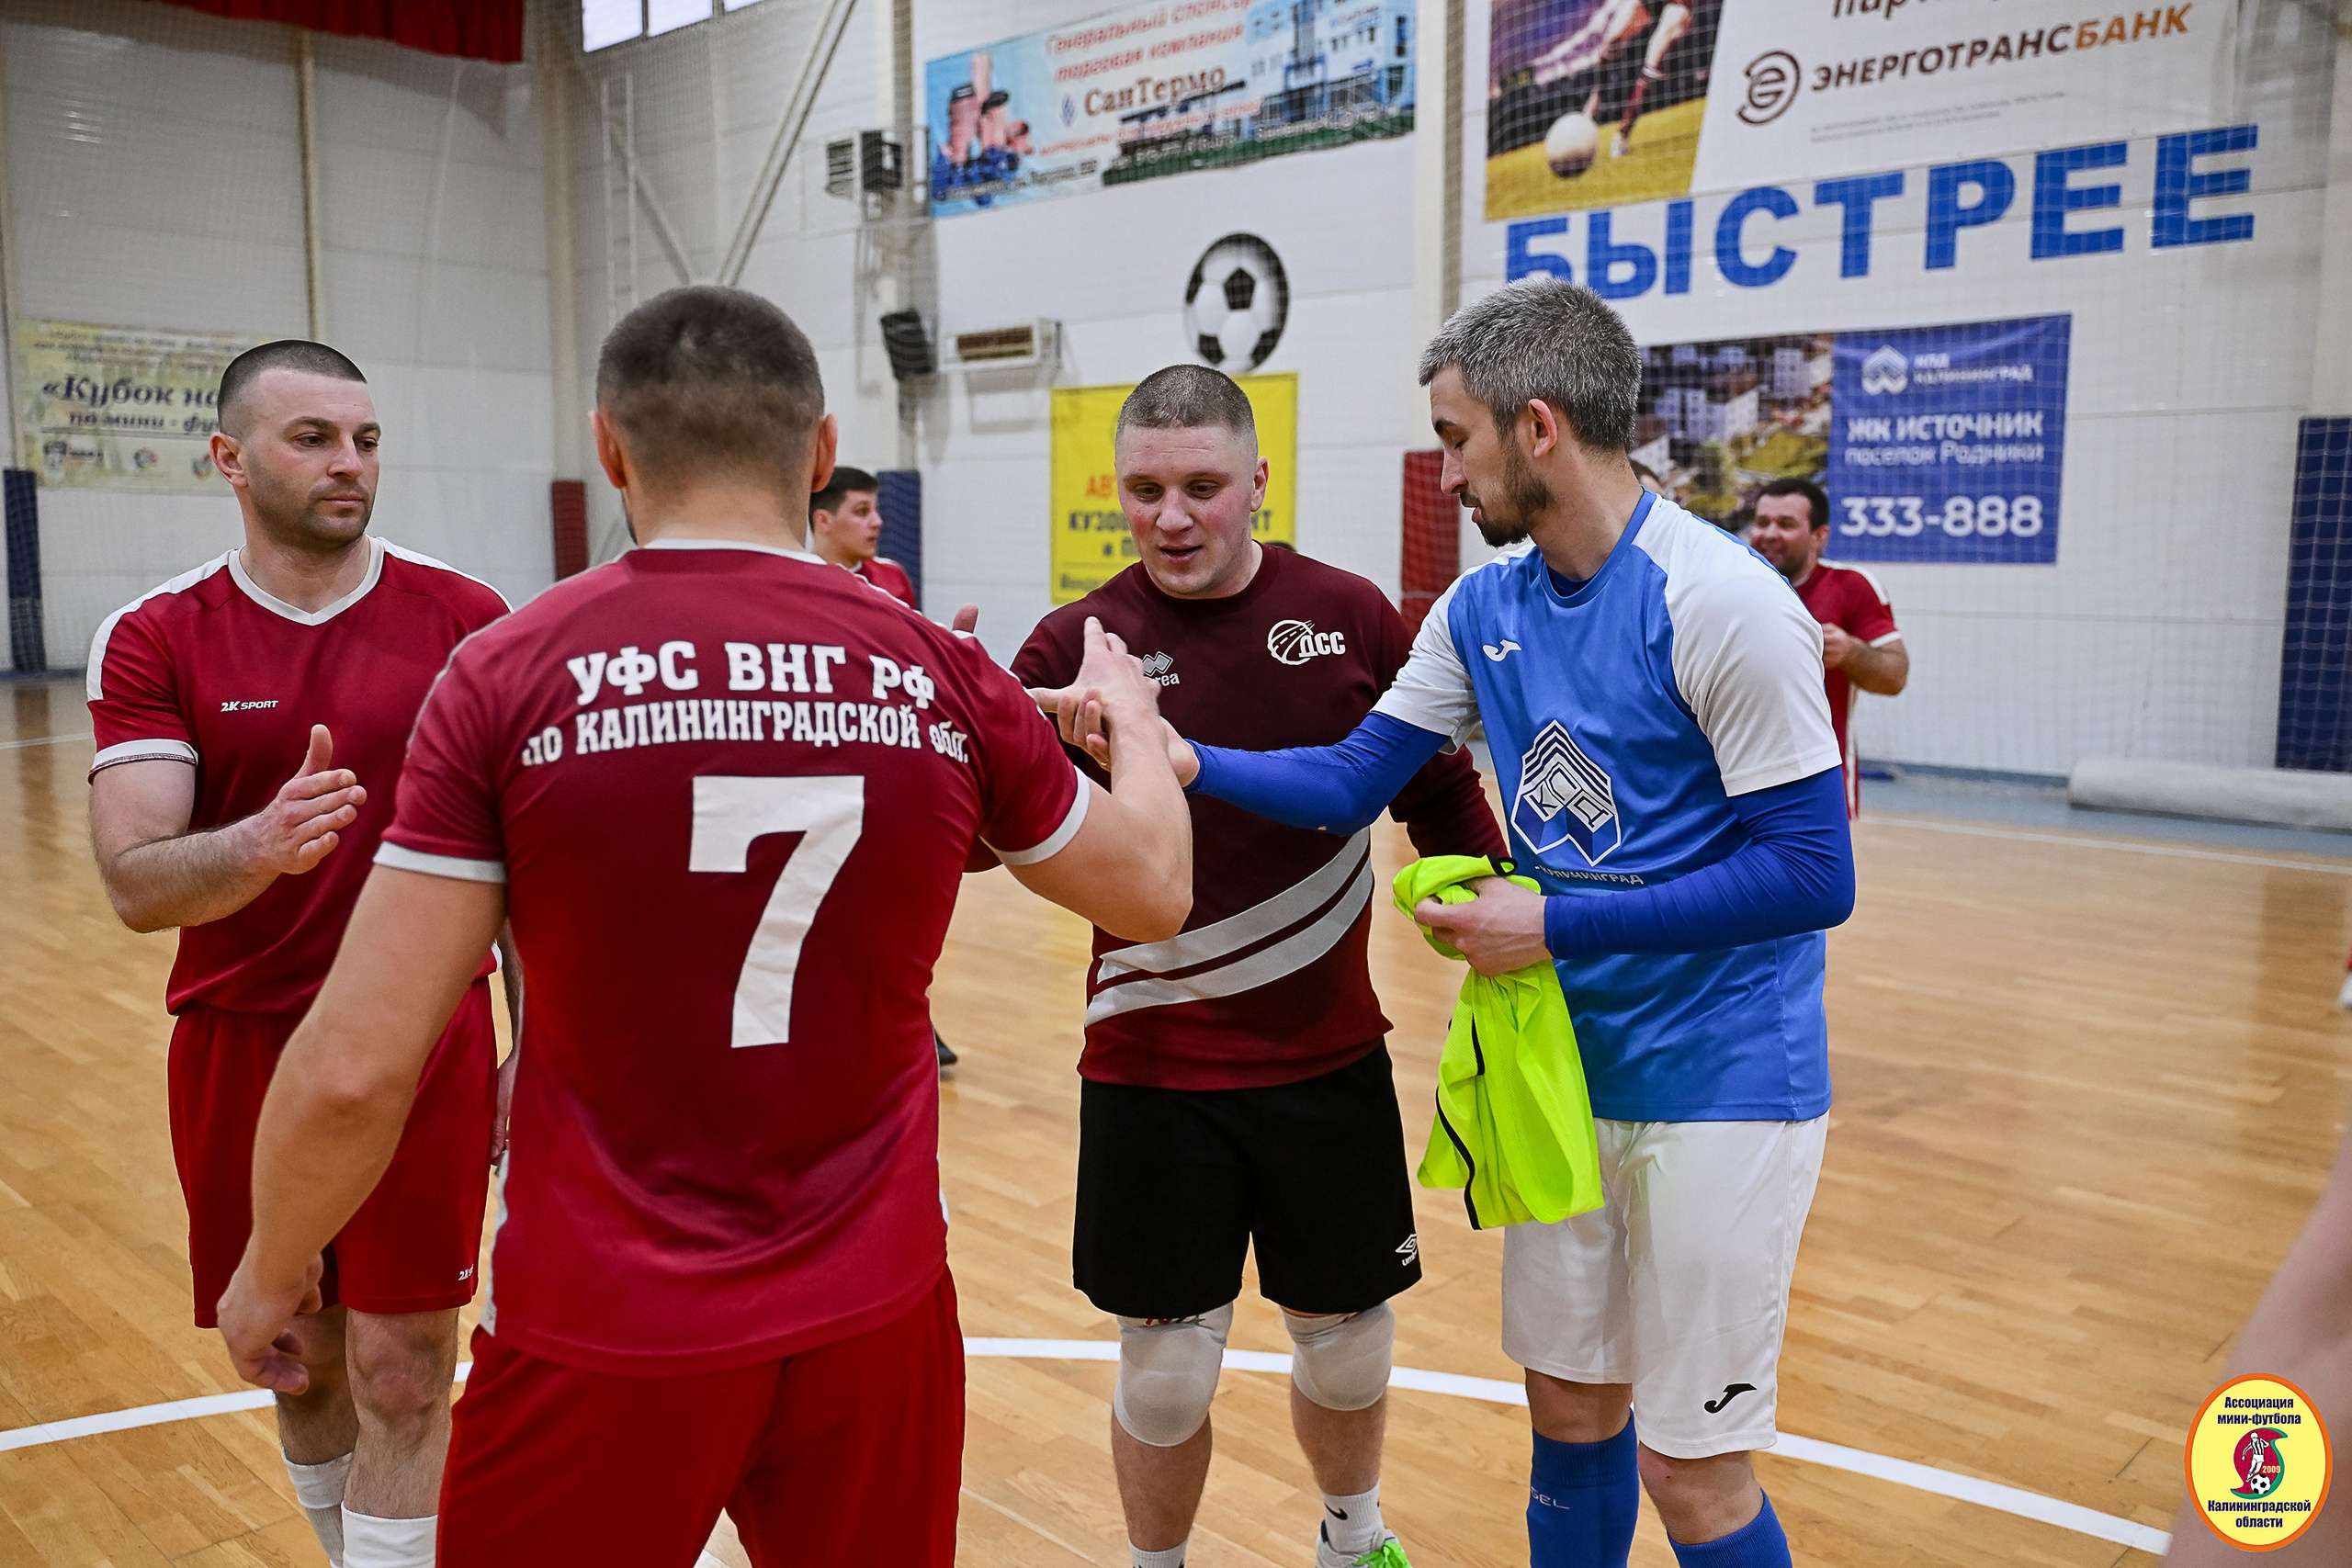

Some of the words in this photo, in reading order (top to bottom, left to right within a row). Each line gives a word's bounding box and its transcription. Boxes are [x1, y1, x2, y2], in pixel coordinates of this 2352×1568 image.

[1811, 4, 2193, 93] ЭНЕРГОТРАНСБАНК
[1084, 66, 1226, 117] СанТермо
[1505, 125, 2258, 300] БЫСТРЕЕ
[1847, 417, 1892, 443] ЖК
[1896, 410, 2043, 442] ИСТОЧНИК
[1839, 495, 2043, 537] 333-888
[1298, 631, 1346, 659] ДСС
[567, 640, 700, 705] УФС
[724, 641, 846, 694] ВНГ
[868, 654, 935, 710] РФ
[240, 700, 278, 710] SPORT
[575, 698, 922, 755] КАЛИНИНГРАДСКОЙ
[688, 775, 865, 1048] 7
